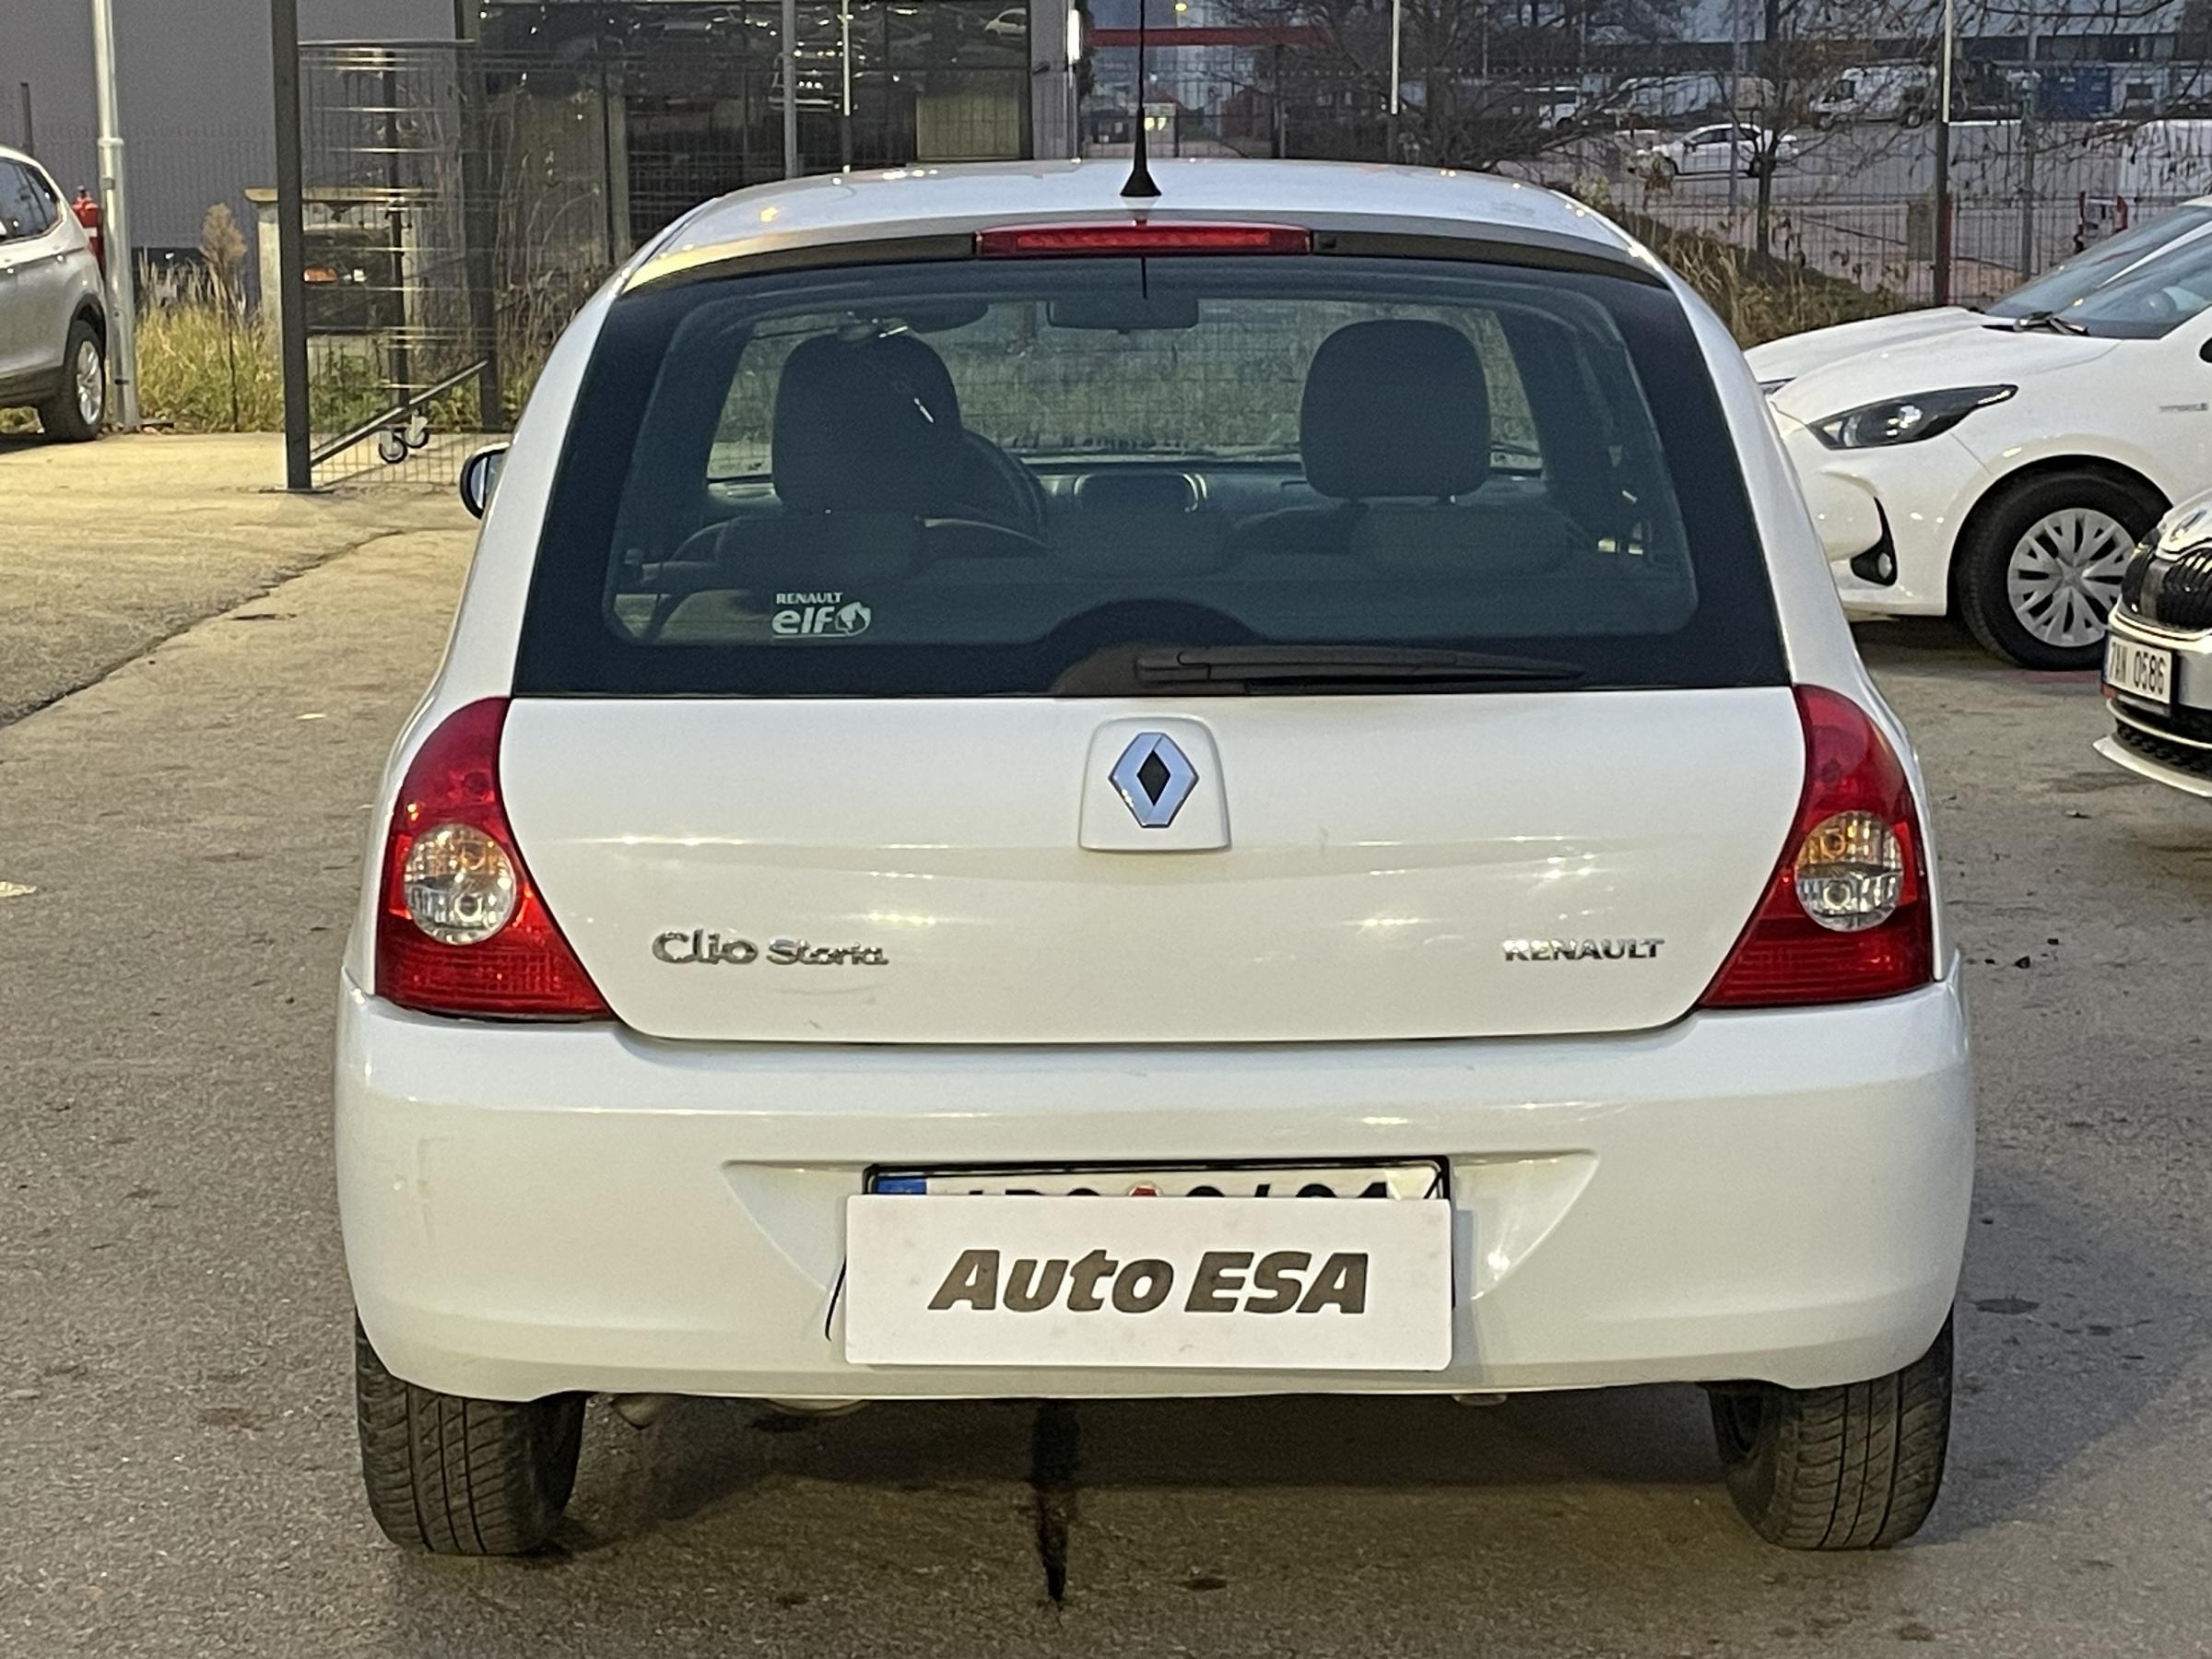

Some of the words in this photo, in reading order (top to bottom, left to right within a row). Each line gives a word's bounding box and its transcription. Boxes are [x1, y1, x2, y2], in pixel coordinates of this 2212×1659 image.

[776, 592, 843, 605] RENAULT
[771, 606, 835, 634] elf
[2134, 650, 2166, 695] 0586
[652, 928, 759, 966] Clio
[766, 937, 889, 966] Storia
[1502, 938, 1665, 962] RENAULT
[927, 1248, 1174, 1314] Auto
[1184, 1250, 1370, 1315] ESA
